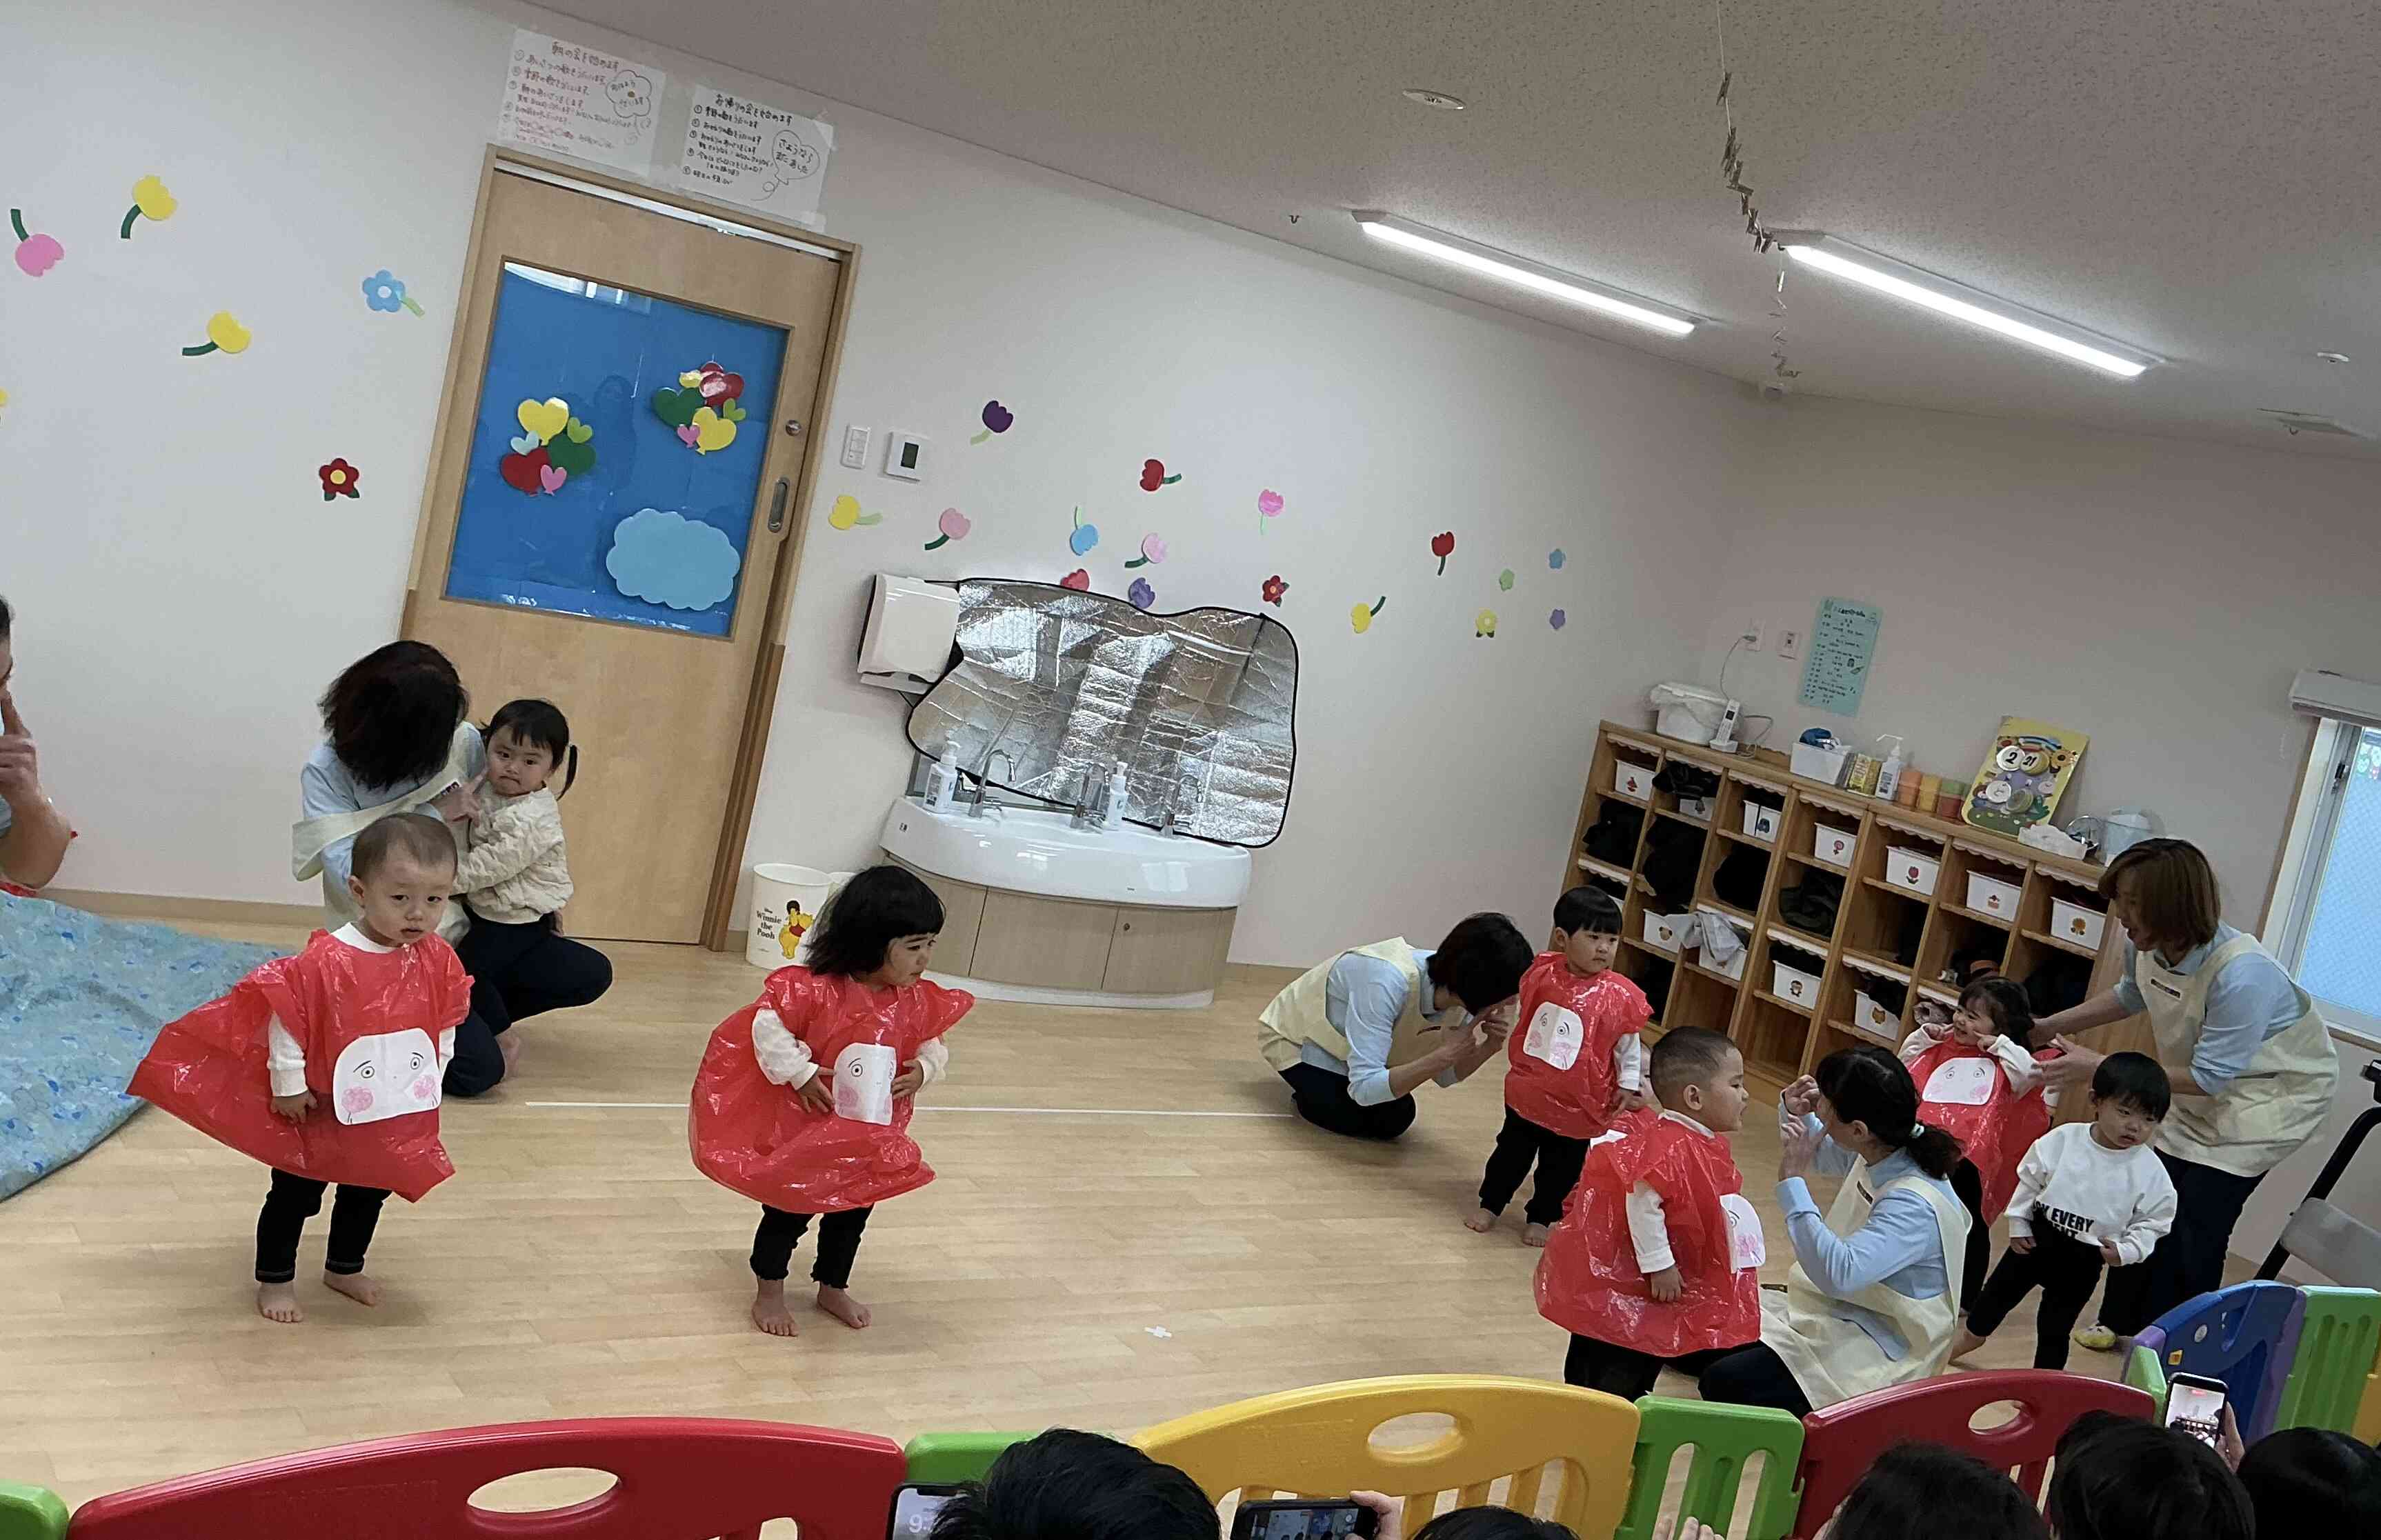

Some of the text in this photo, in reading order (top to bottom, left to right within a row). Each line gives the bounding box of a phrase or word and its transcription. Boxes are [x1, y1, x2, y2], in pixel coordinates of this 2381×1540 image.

[715, 94, 793, 126] お帰りの会を始めます
[779, 139, 813, 163] さようなら
[776, 150, 808, 174] またあした
[2006, 752, 2038, 766] 2 21
[756, 910, 782, 924] Winnie
[761, 921, 773, 930] the
[757, 928, 775, 939] Pooh
[2051, 1208, 2095, 1232] EVERY
